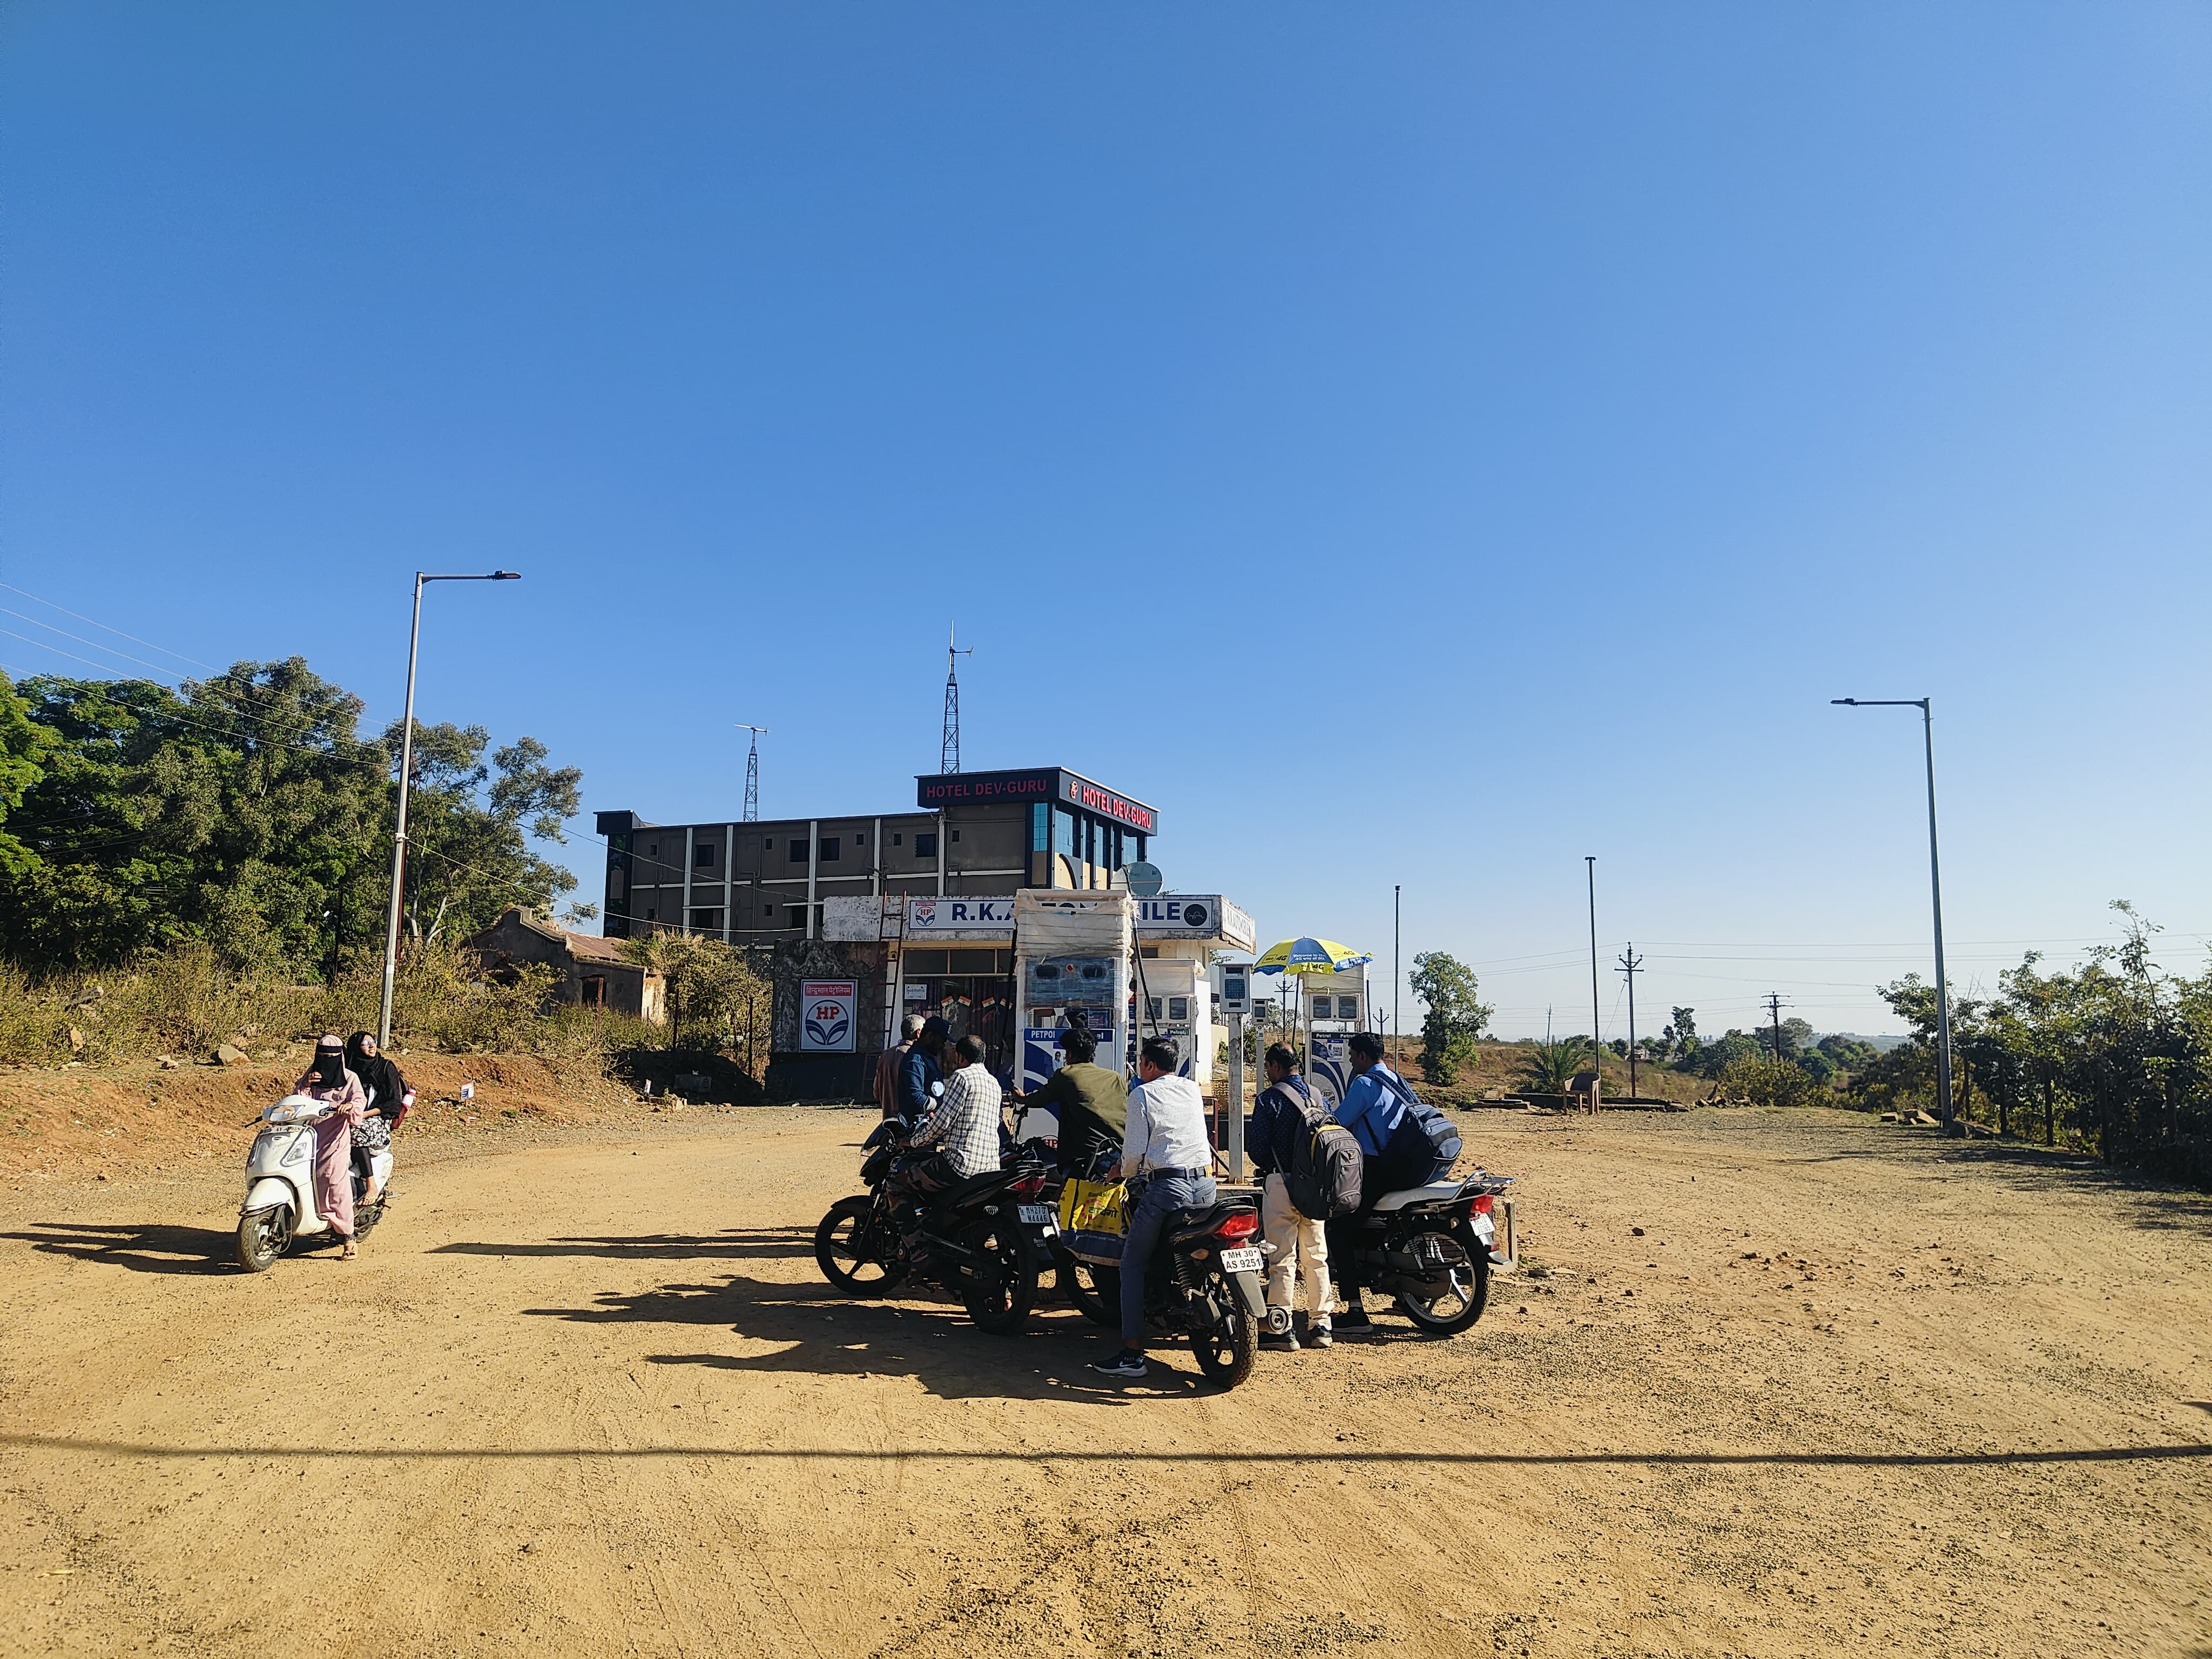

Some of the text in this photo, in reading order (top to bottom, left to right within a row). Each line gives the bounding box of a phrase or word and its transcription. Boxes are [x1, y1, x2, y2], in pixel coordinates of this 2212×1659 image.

[926, 779, 1047, 798] HOTEL DEV-GURU
[1082, 785, 1151, 829] HOTEL DEV-GURU
[816, 1006, 839, 1020] HP
[1228, 1251, 1242, 1259] MH
[1226, 1258, 1261, 1270] AS 9251
